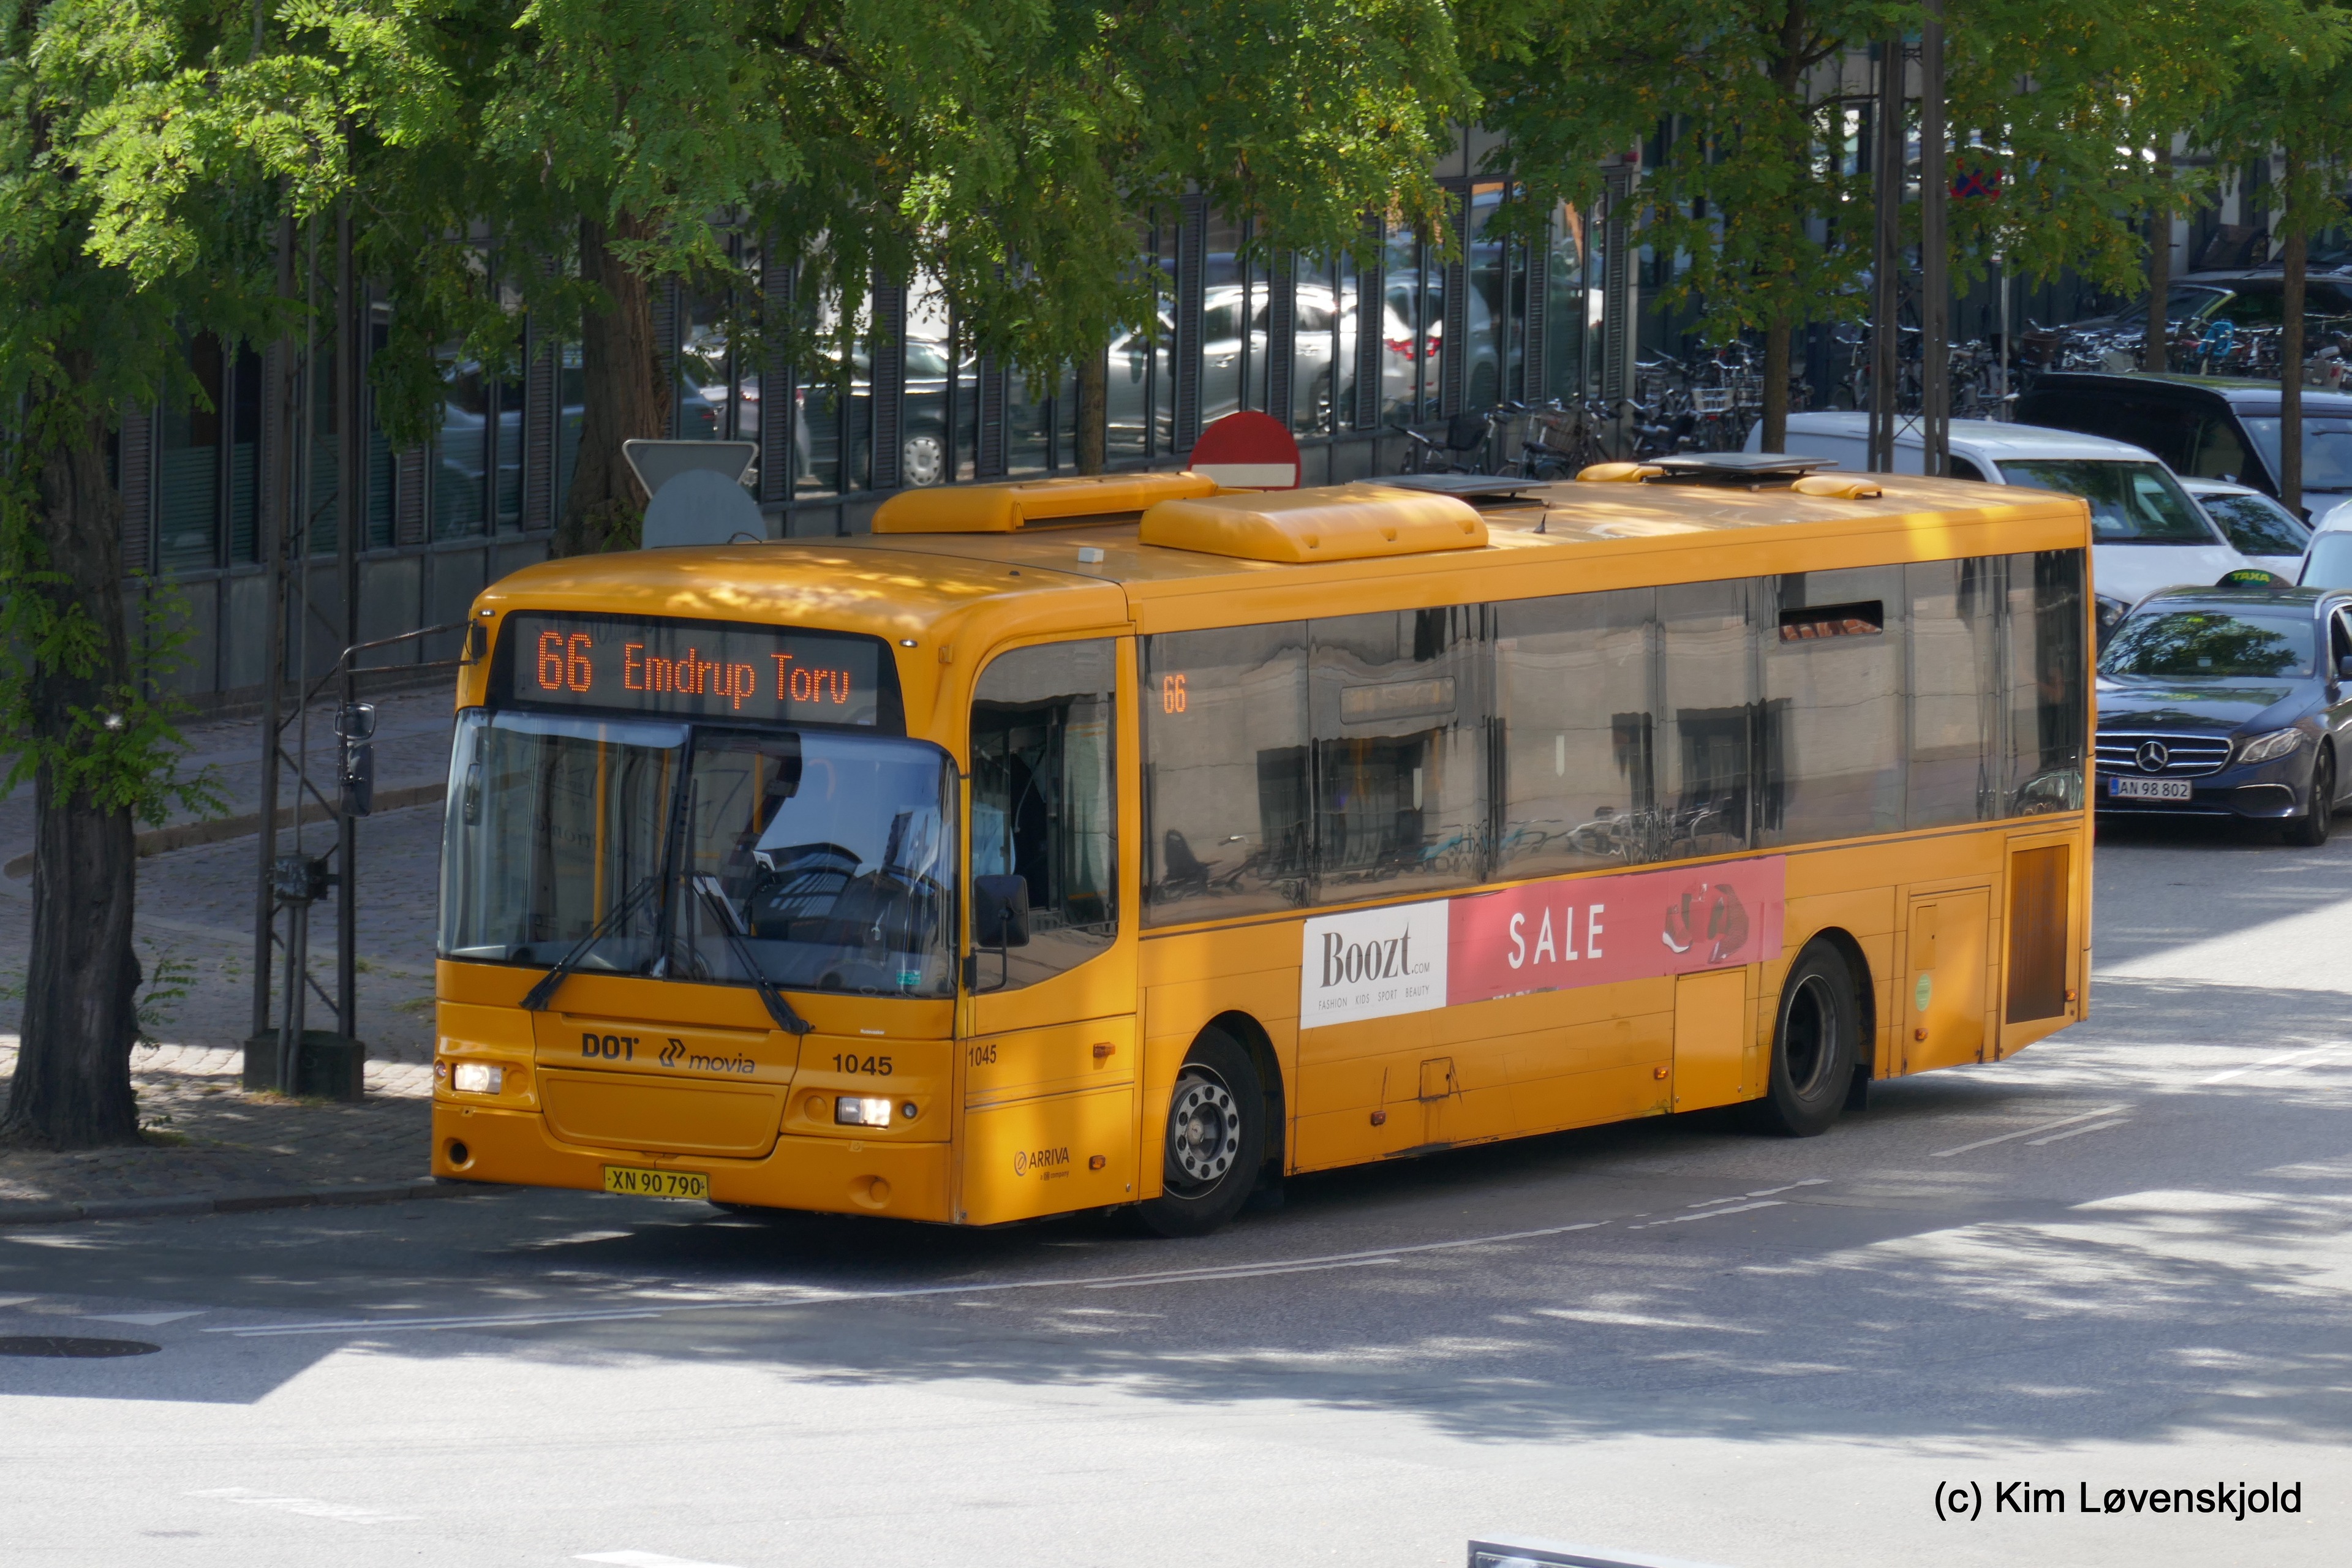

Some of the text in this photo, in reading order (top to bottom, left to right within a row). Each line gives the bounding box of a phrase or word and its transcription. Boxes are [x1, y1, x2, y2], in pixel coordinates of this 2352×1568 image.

[2233, 572, 2271, 582] TAXA
[538, 631, 850, 710] 66 Emdrup Torv
[1163, 674, 1186, 714] 66
[2120, 782, 2138, 794] AN
[2142, 782, 2158, 796] 98
[2162, 783, 2187, 797] 802
[1507, 904, 1605, 970] SALE
[1318, 985, 1430, 1011] FASHION KIDS SPORT BEAUTY
[581, 1033, 639, 1061] DOT
[968, 1044, 997, 1067] 1045
[688, 1052, 755, 1074] movia
[832, 1053, 893, 1076] 1045
[1028, 1147, 1069, 1169] ARRIVA
[612, 1170, 701, 1196] XN 90 790
